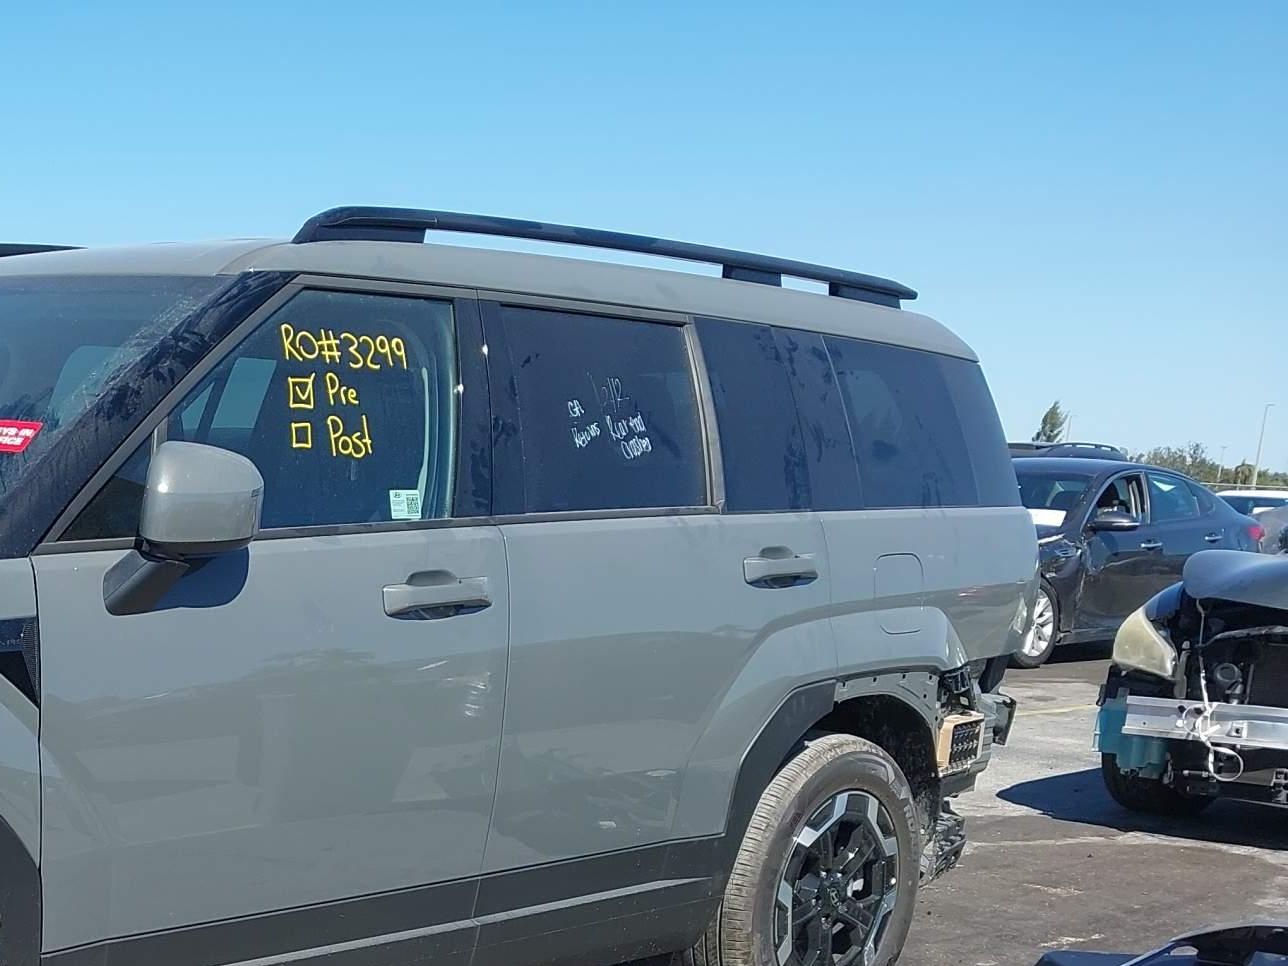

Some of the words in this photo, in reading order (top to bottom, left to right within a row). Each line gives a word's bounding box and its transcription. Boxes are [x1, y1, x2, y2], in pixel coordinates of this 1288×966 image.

[280, 323, 408, 370] RO#3299
[325, 372, 360, 406] Pre
[327, 414, 373, 459] Post
